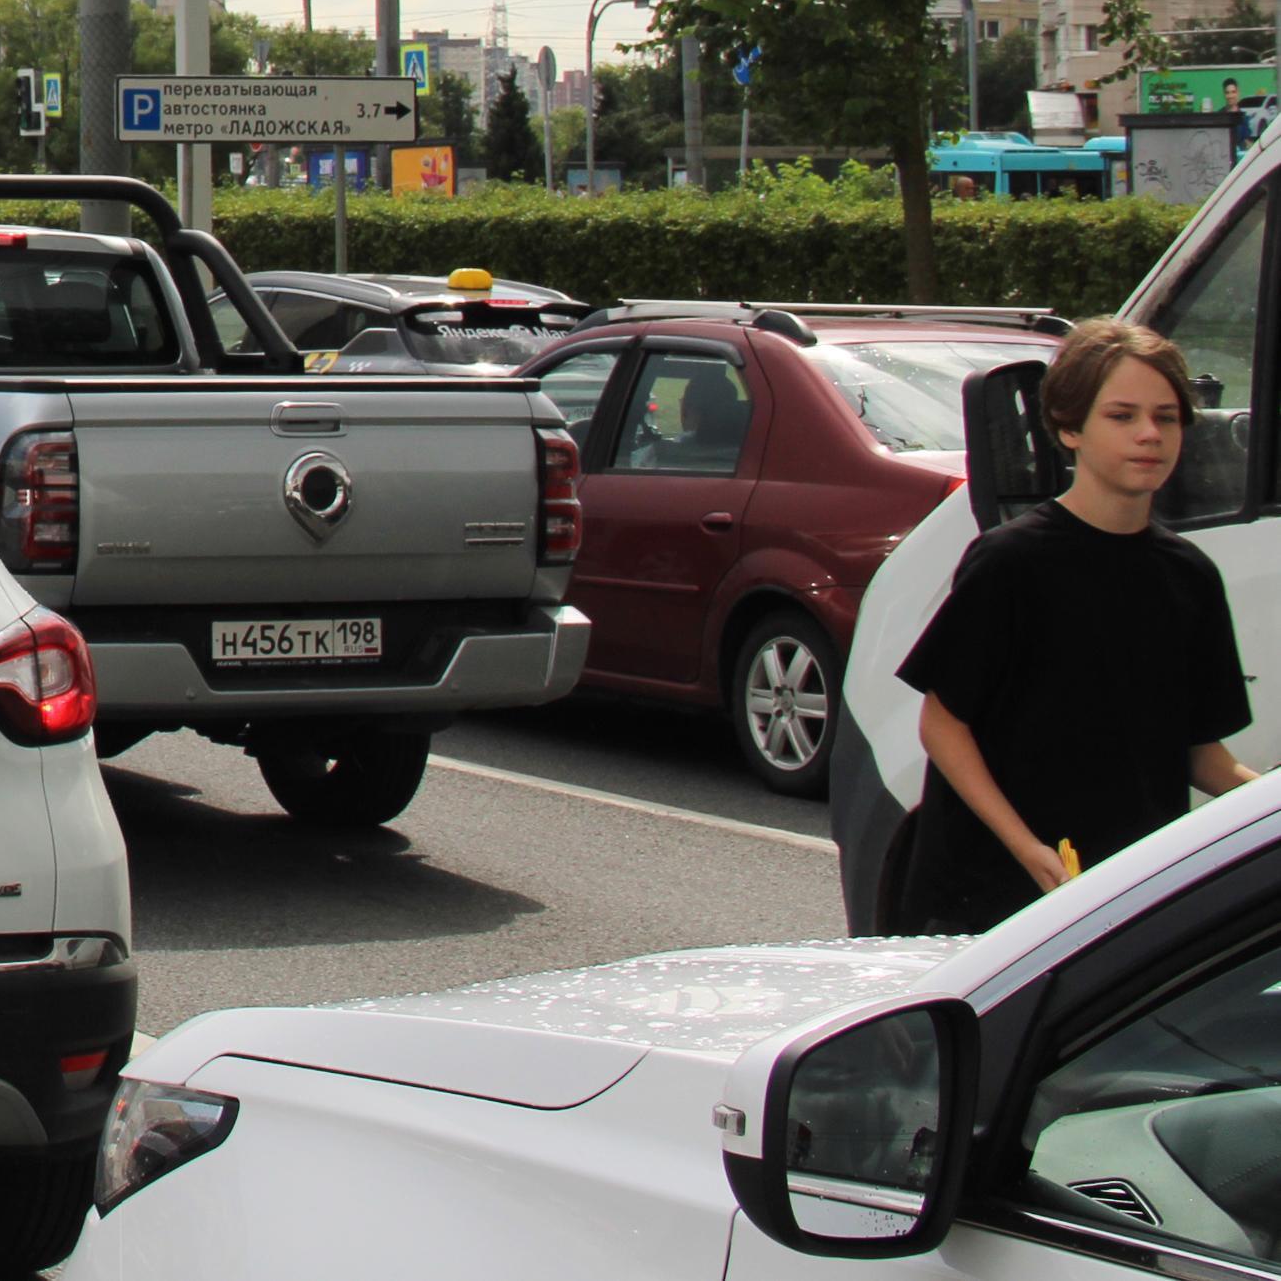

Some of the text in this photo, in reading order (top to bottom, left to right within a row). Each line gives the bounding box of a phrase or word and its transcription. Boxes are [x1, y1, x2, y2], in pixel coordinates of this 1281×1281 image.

[163, 84, 317, 99] перехватывающая
[163, 103, 266, 116] автостоянка
[356, 103, 381, 119] 3.7
[163, 119, 352, 139] метро «ЛАДОЖСКАЯ»
[437, 325, 509, 339] Яндекс
[221, 621, 375, 656] Н456ТК 198
[344, 645, 364, 654] RUS
